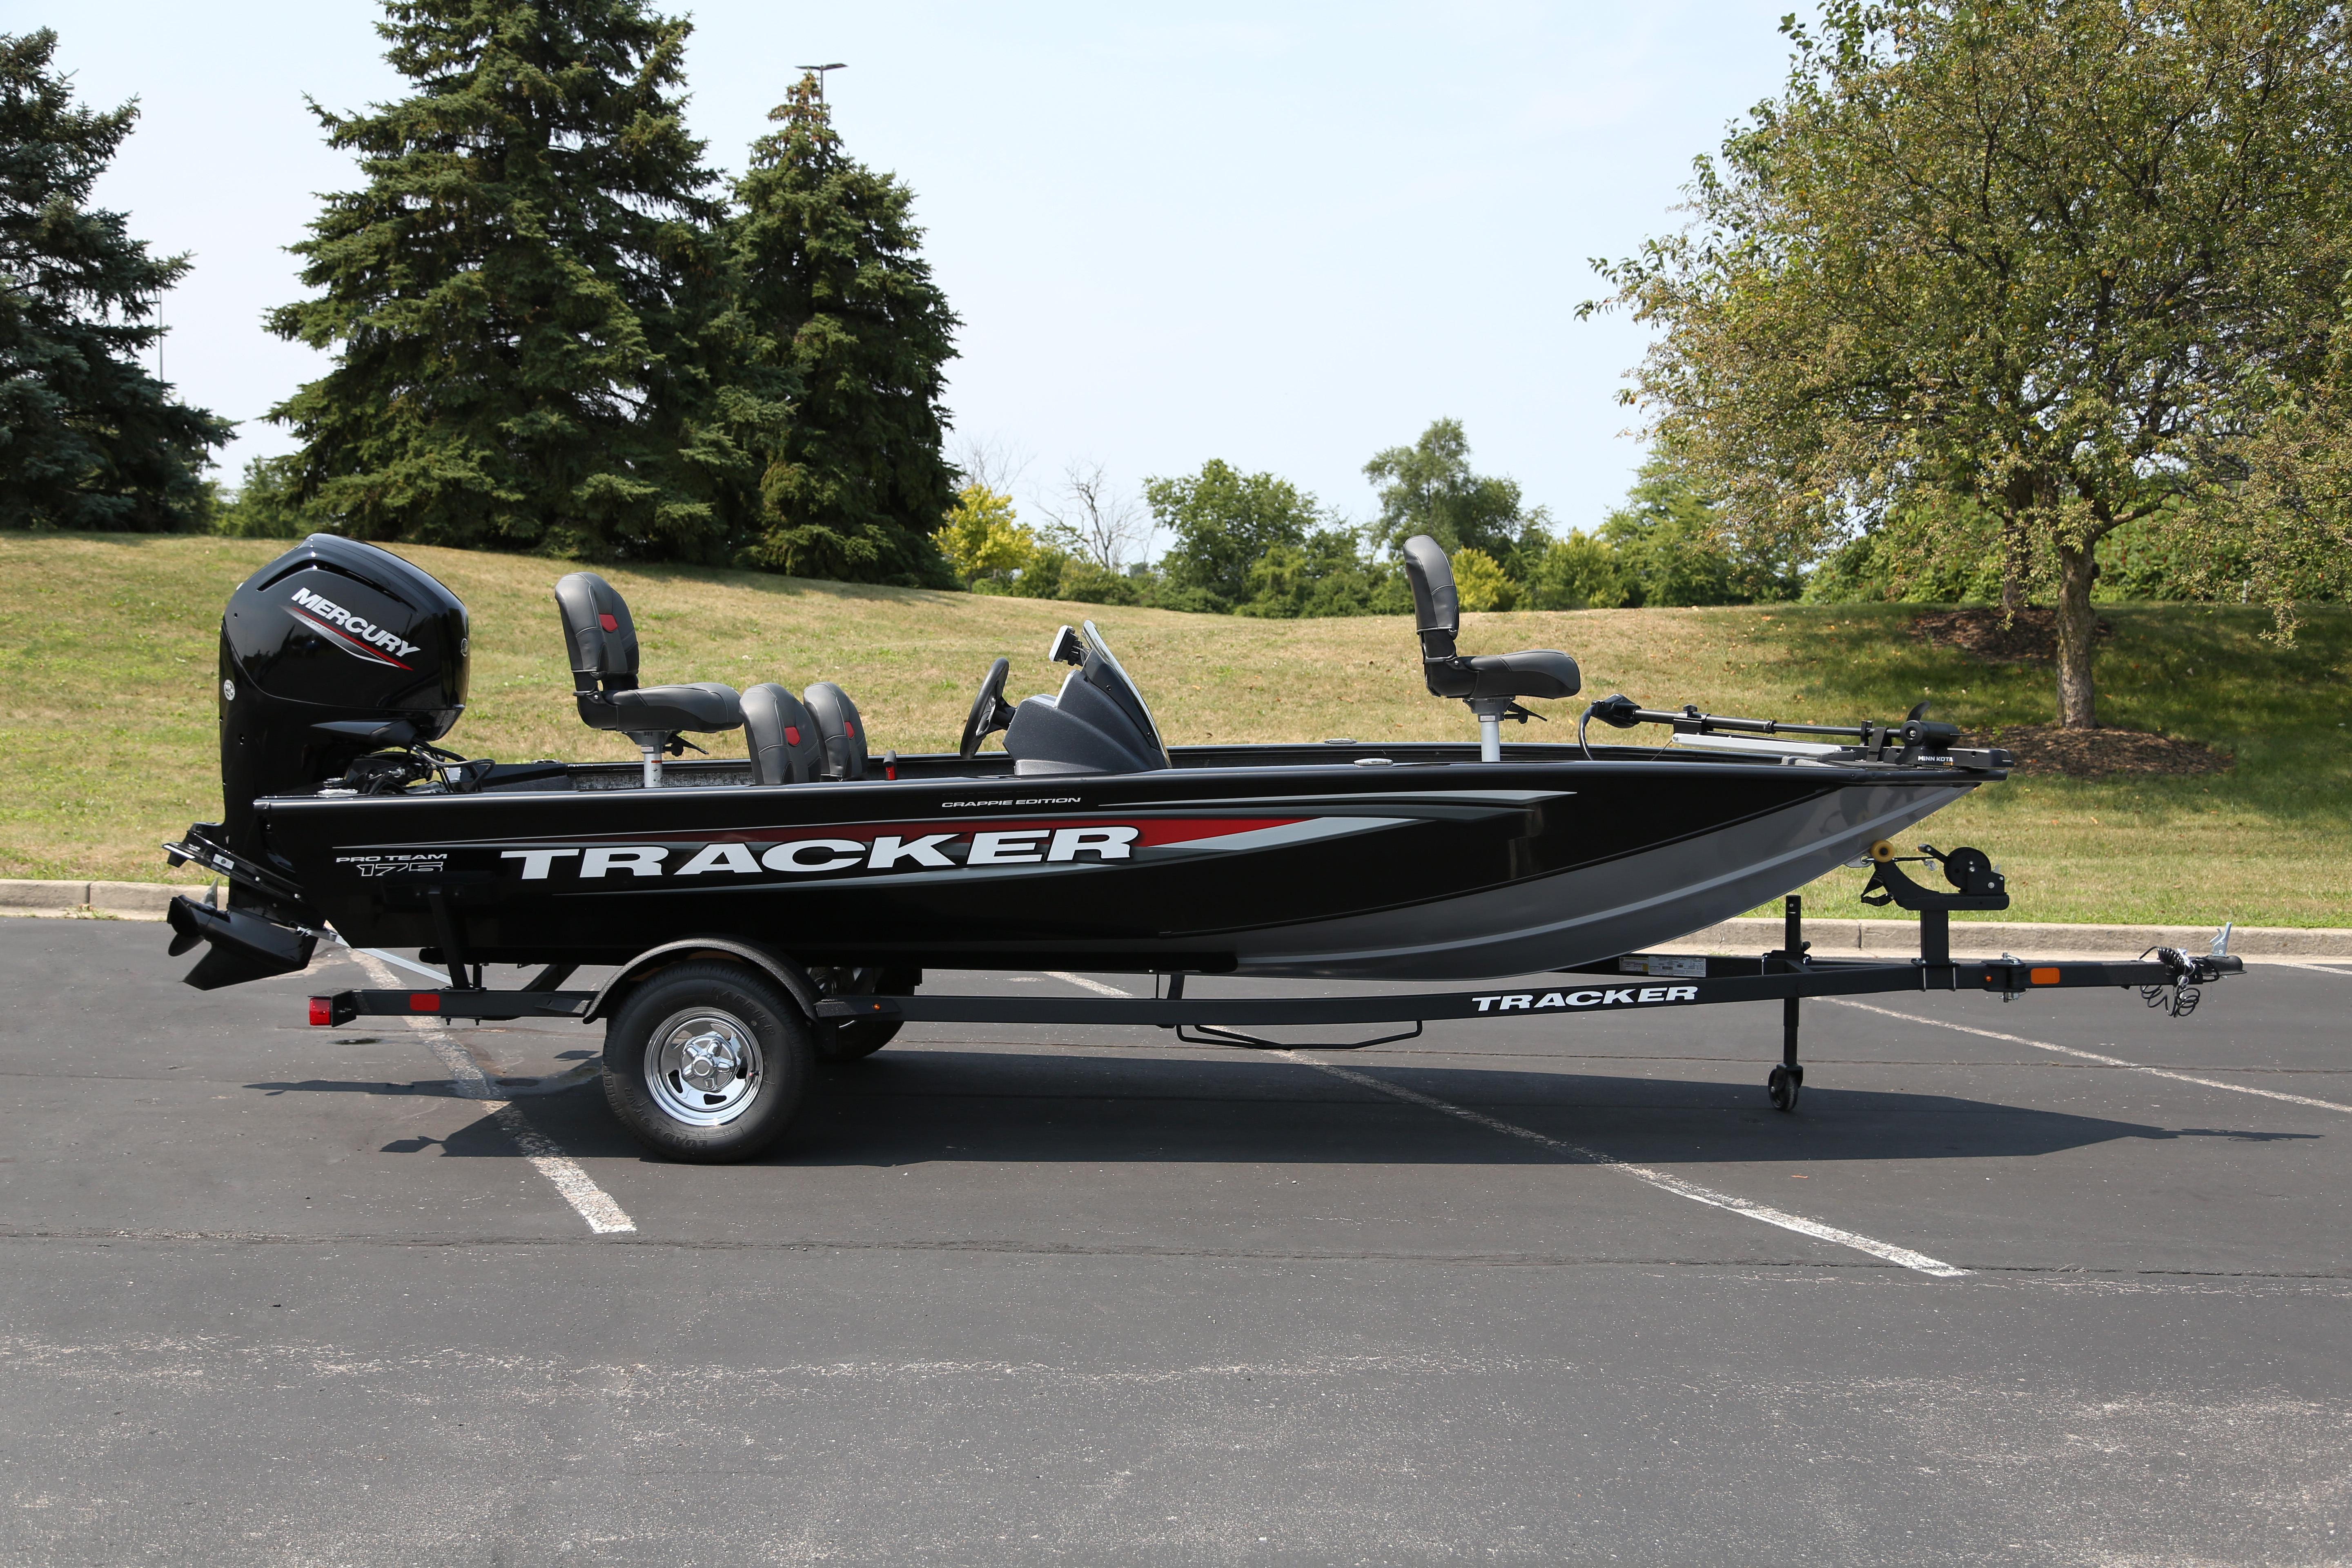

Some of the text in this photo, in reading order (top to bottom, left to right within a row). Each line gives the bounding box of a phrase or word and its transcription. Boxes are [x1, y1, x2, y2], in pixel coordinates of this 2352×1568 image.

[291, 587, 421, 657] MERCURY
[501, 826, 1139, 880] TRACKER
[356, 862, 444, 877] 175
[1472, 986, 1698, 1011] TRACKER
[662, 1131, 708, 1149] LOAD
